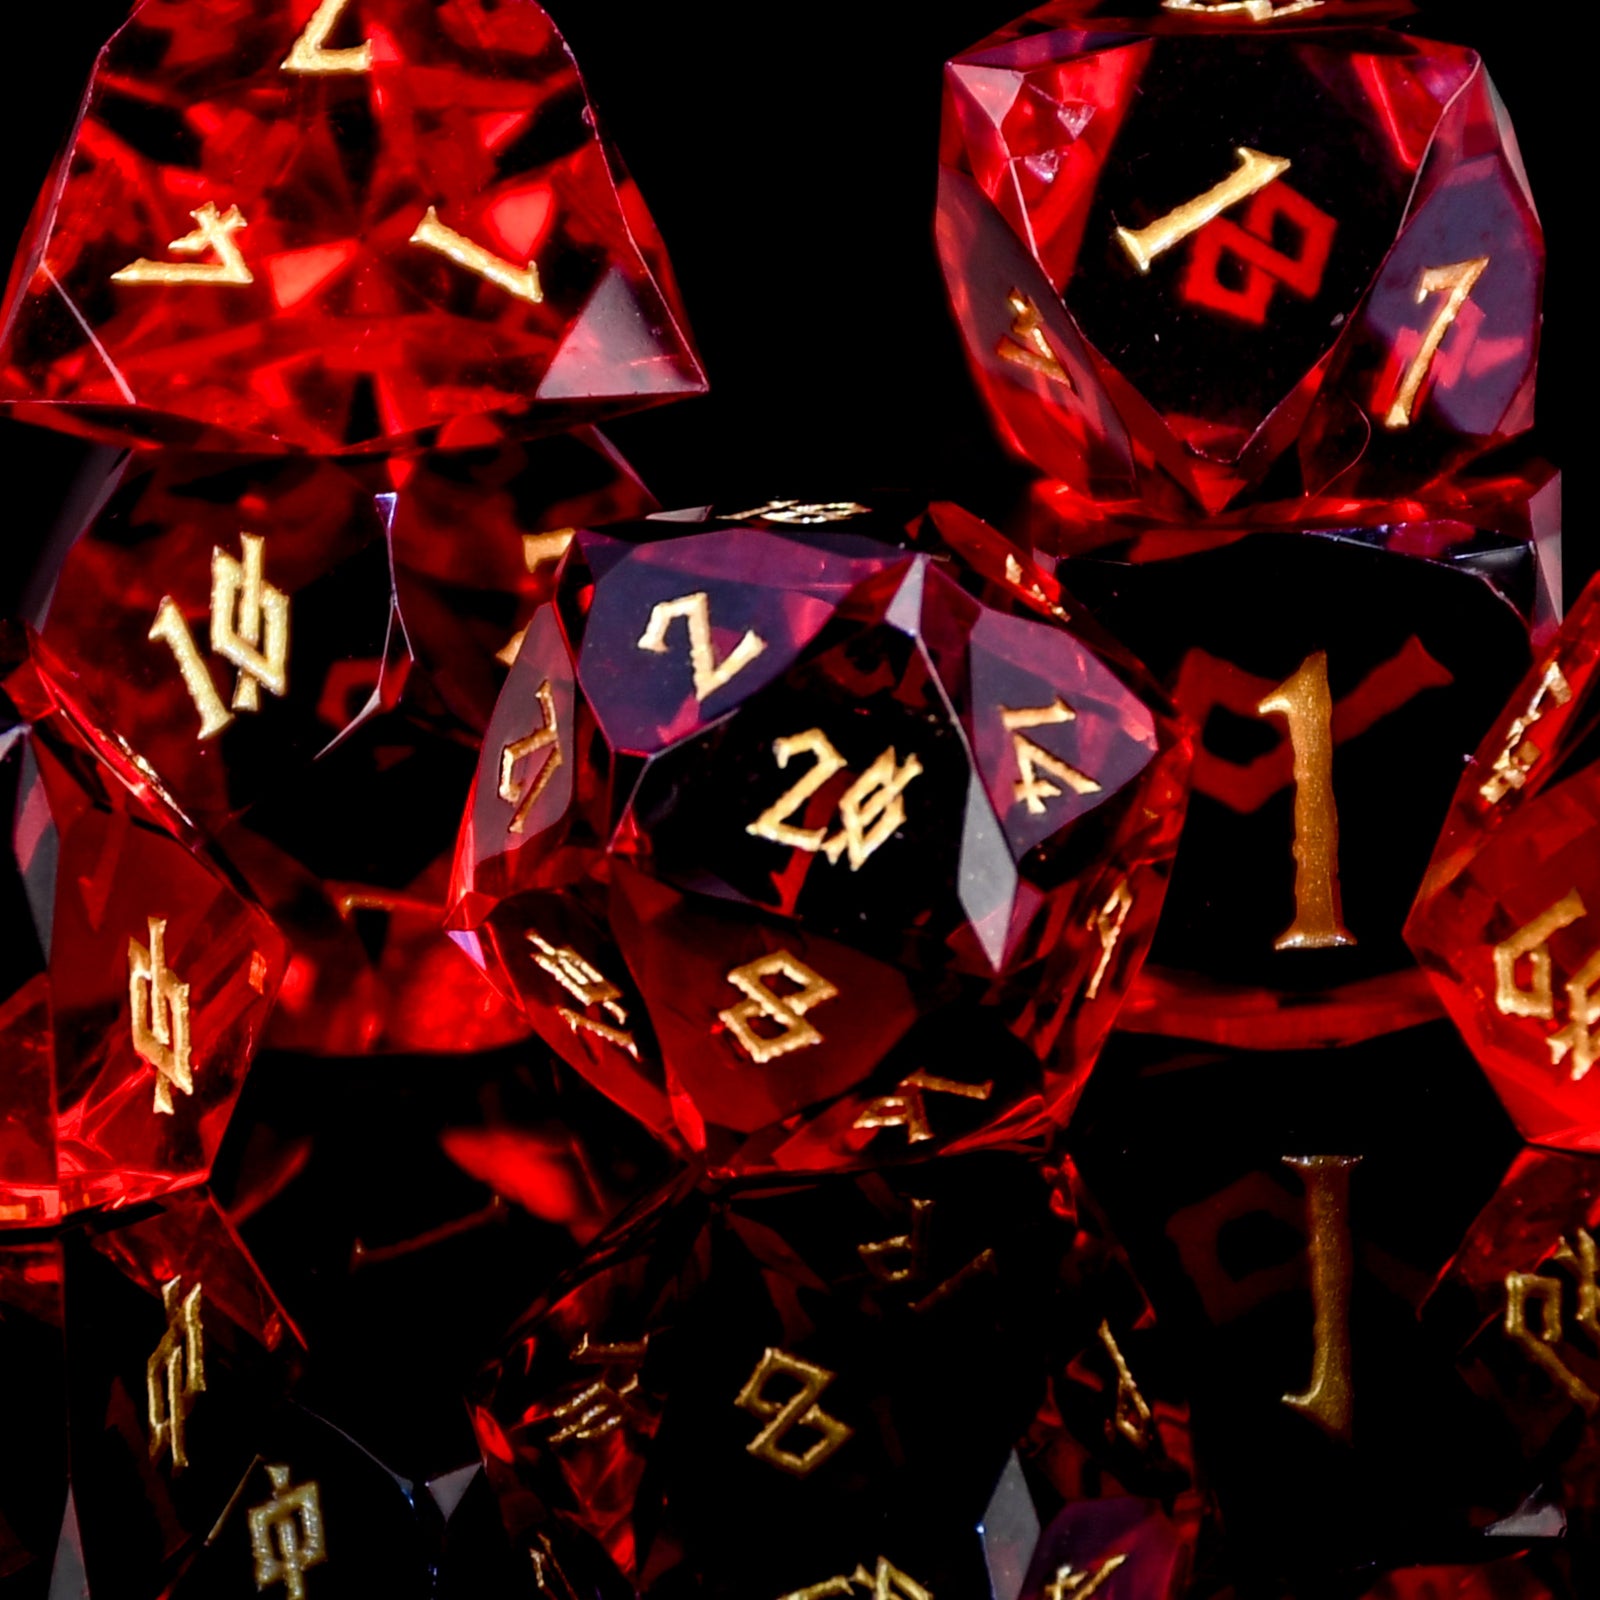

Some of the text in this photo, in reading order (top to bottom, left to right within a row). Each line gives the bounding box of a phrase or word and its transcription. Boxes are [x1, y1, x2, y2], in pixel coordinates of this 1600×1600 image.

[110, 201, 253, 285] 4
[408, 204, 544, 304] 1
[1117, 146, 1292, 272] 1
[1385, 256, 1489, 428] 7
[147, 531, 291, 740] 10
[637, 591, 767, 702] 2
[745, 727, 924, 872] 20
[1257, 650, 1358, 951] 1
[718, 948, 838, 1064] 8
